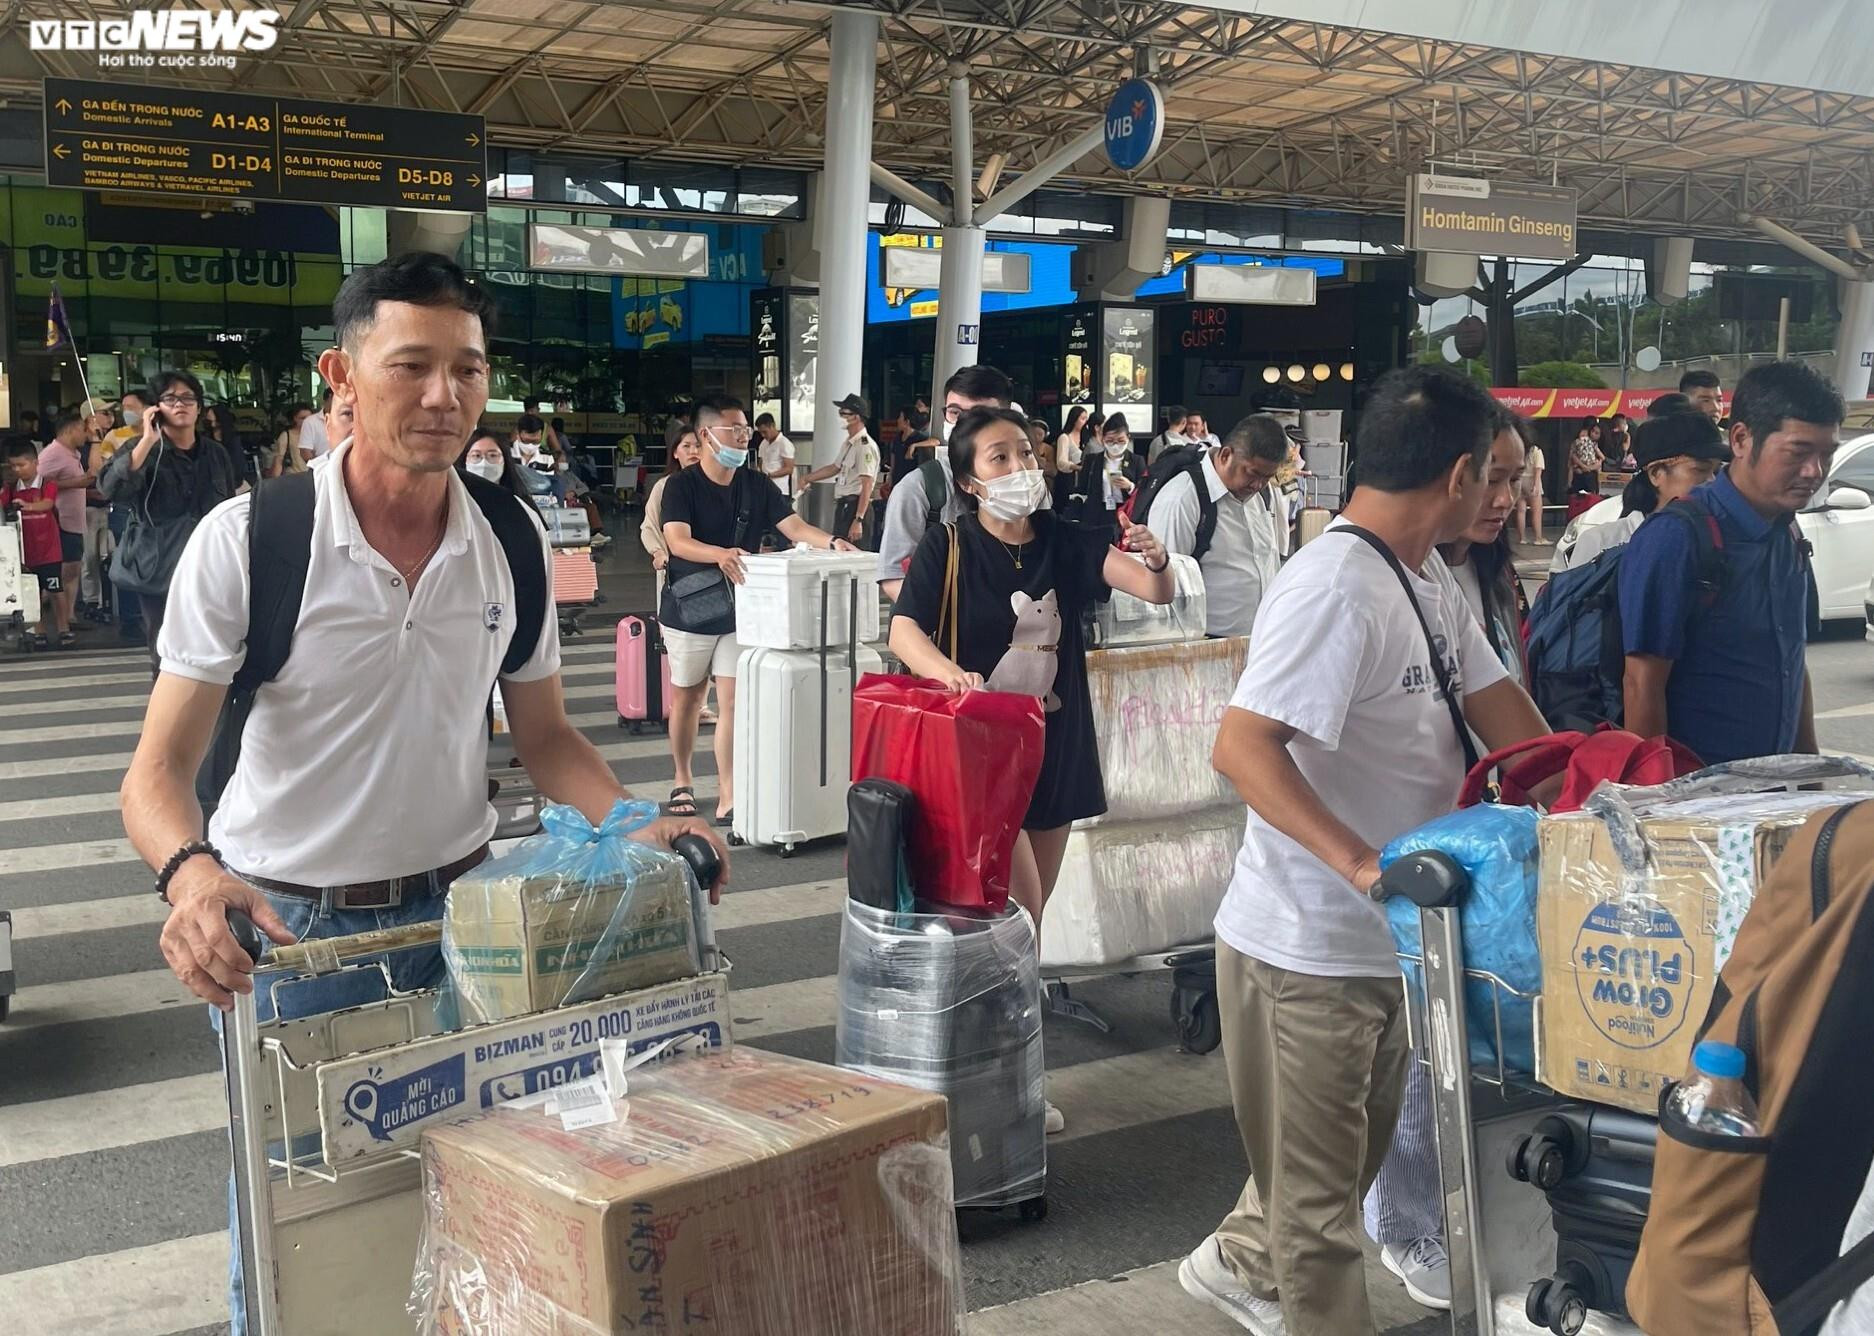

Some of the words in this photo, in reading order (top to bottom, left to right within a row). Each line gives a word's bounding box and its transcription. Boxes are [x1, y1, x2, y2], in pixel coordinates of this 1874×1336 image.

[82, 100, 100, 110] GA
[102, 98, 126, 112] ĐẾN
[129, 103, 169, 115] TRONG
[171, 104, 203, 118] NƯỚC
[83, 112, 131, 124] Domestic
[134, 117, 173, 127] Arrivals
[212, 113, 270, 132] A1-A3
[283, 114, 298, 123] GA
[300, 114, 331, 125] QUỐC
[333, 115, 347, 127] TẾ
[1107, 115, 1133, 141] VIB
[283, 126, 342, 138] International
[344, 130, 384, 141] Terminal
[82, 140, 100, 150] GA
[102, 141, 114, 151] ĐI
[116, 142, 156, 154] TRONG
[158, 144, 190, 157] NƯỚC
[83, 153, 131, 165] Domestic
[133, 156, 189, 169] Departures
[212, 154, 272, 172] D1-D4
[284, 155, 300, 164] GA
[302, 156, 313, 165] ĐI
[315, 157, 350, 168] TRONG
[353, 158, 382, 170] NƯỚC
[84, 170, 119, 179] VIETNAM
[188, 176, 216, 185] PACIFIC
[285, 167, 328, 179] Domestic
[331, 171, 381, 182] Departures
[399, 168, 453, 186] D5-D8
[84, 178, 119, 187] BAMBOO
[121, 179, 155, 189] AIRWAYS
[207, 185, 240, 194] AIRLINES
[401, 191, 435, 201] VIETJET
[437, 193, 451, 203] AIR
[1423, 206, 1505, 233] Homtamin
[1509, 215, 1572, 242] Ginseng
[1192, 308, 1226, 326] PURO
[1182, 329, 1226, 348] GUSTO
[46, 576, 60, 589] 21
[1581, 944, 1681, 984] PLUS+
[635, 1007, 645, 1017] XE
[548, 1025, 566, 1038] CUNG
[569, 1009, 632, 1047] 20.000
[1608, 1017, 1655, 1038] Nutifood
[475, 1031, 545, 1063] BIZMAN
[408, 1077, 432, 1100] MỜI
[382, 1099, 426, 1129] QUẢNG
[431, 1085, 456, 1110] CÁO
